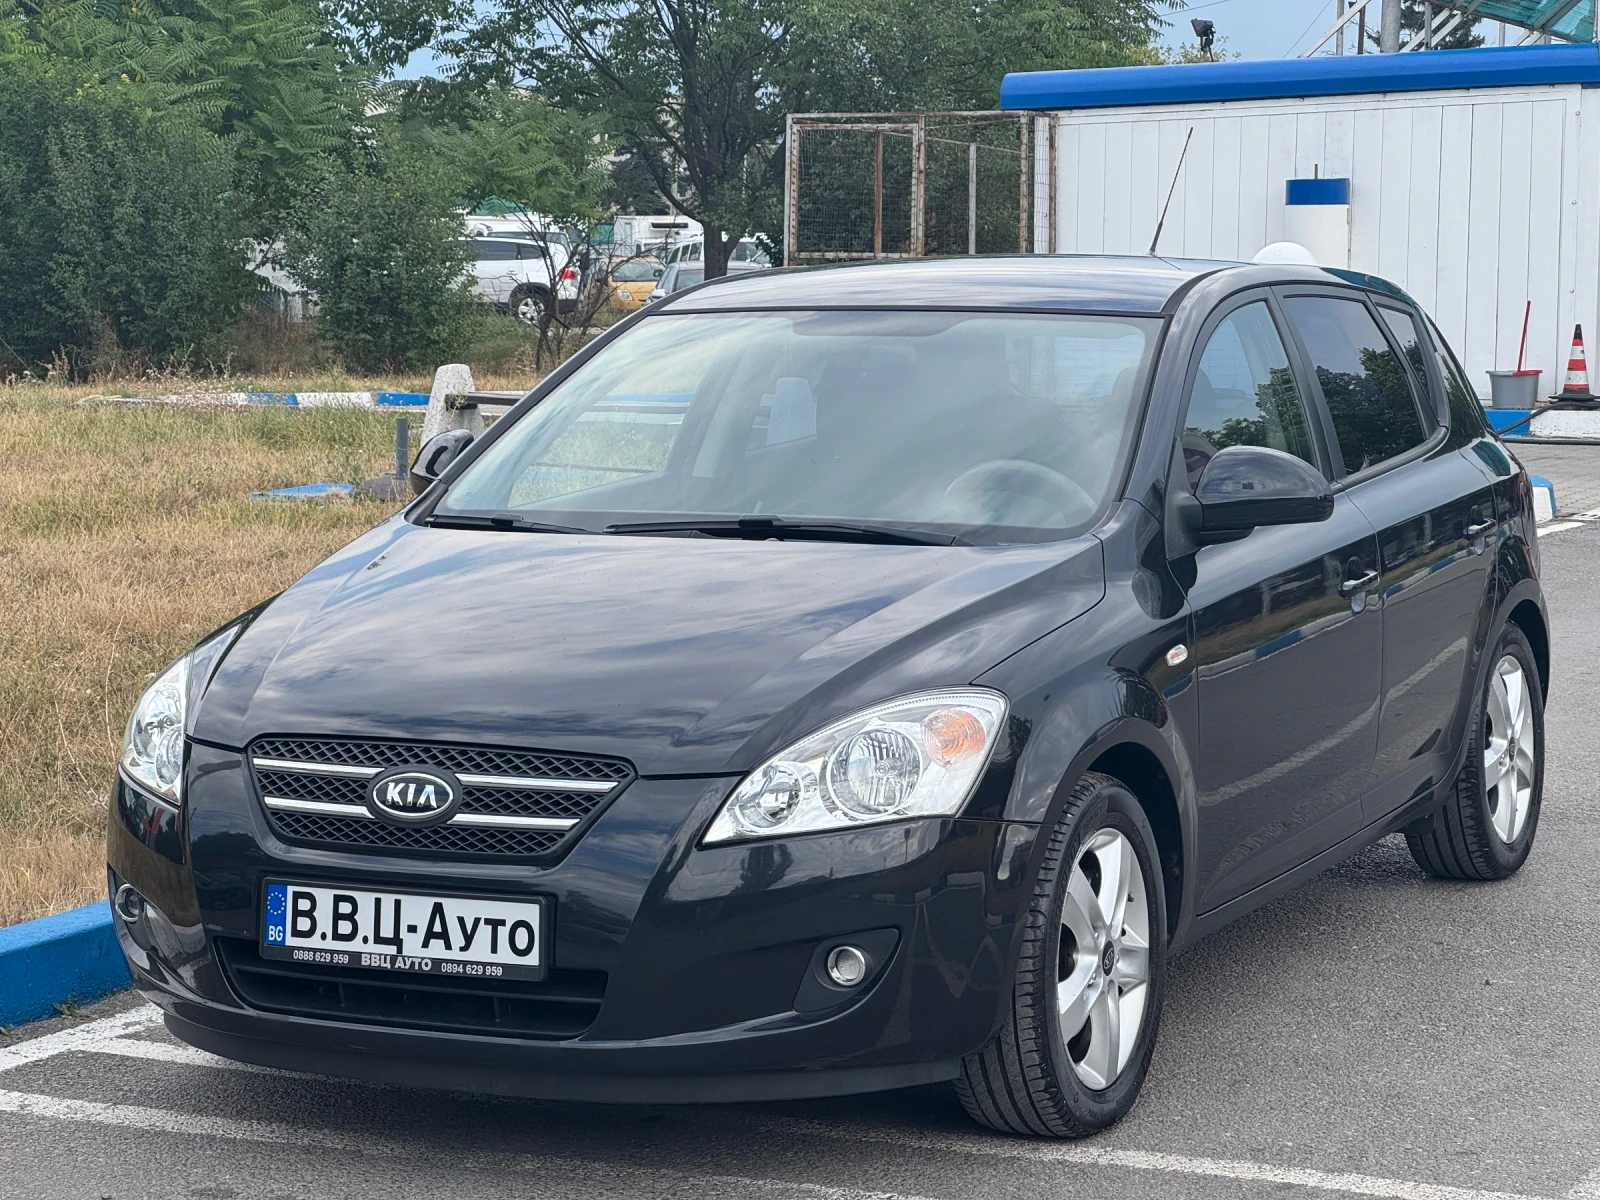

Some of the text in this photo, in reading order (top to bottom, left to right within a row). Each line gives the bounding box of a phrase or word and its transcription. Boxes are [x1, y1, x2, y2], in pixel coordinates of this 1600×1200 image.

[386, 782, 437, 808] KIA
[268, 925, 283, 941] BG
[293, 950, 349, 964] 0888 629 959
[361, 953, 432, 971] ВВЦ АУТО
[441, 962, 503, 976] 0894 629 959
